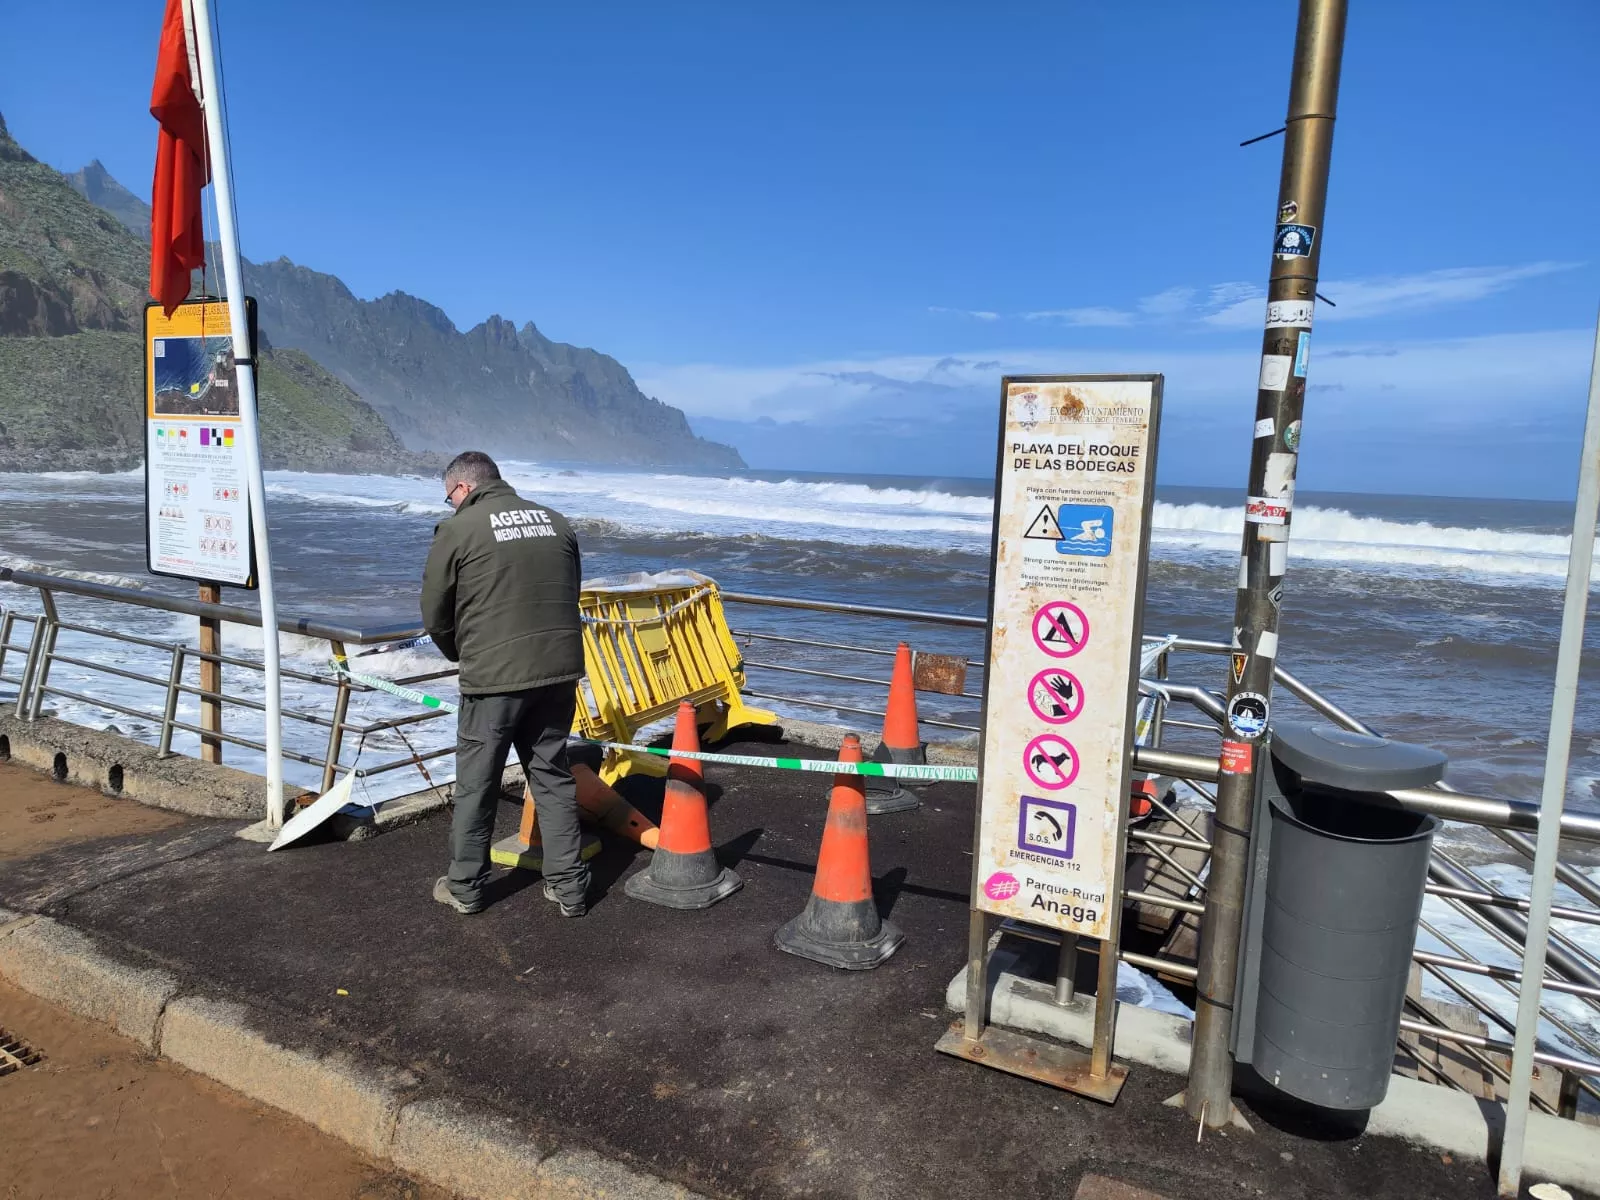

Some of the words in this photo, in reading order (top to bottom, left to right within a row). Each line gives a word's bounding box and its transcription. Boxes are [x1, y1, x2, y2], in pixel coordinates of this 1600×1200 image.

[1082, 406, 1144, 417] AYUNTAMIENTO
[1013, 443, 1054, 455] PLAYA
[1057, 444, 1085, 456] DEL
[1089, 445, 1140, 457] ROQUE
[1014, 458, 1031, 469] DE
[1035, 459, 1061, 470] LAS
[1066, 460, 1136, 473] BODEGAS
[1026, 486, 1044, 495] Playa
[489, 509, 551, 528] AGENTE
[493, 526, 522, 543] MEDIO
[520, 524, 557, 538] NATURAL
[893, 766, 941, 779] AGENTES
[1028, 833, 1051, 844] S.O.S.
[1009, 850, 1065, 868] EMERGENCIAS
[1067, 862, 1081, 871] 112
[1026, 877, 1070, 896] Parque
[1072, 888, 1105, 904] Rural
[1031, 894, 1097, 923] Anaga
